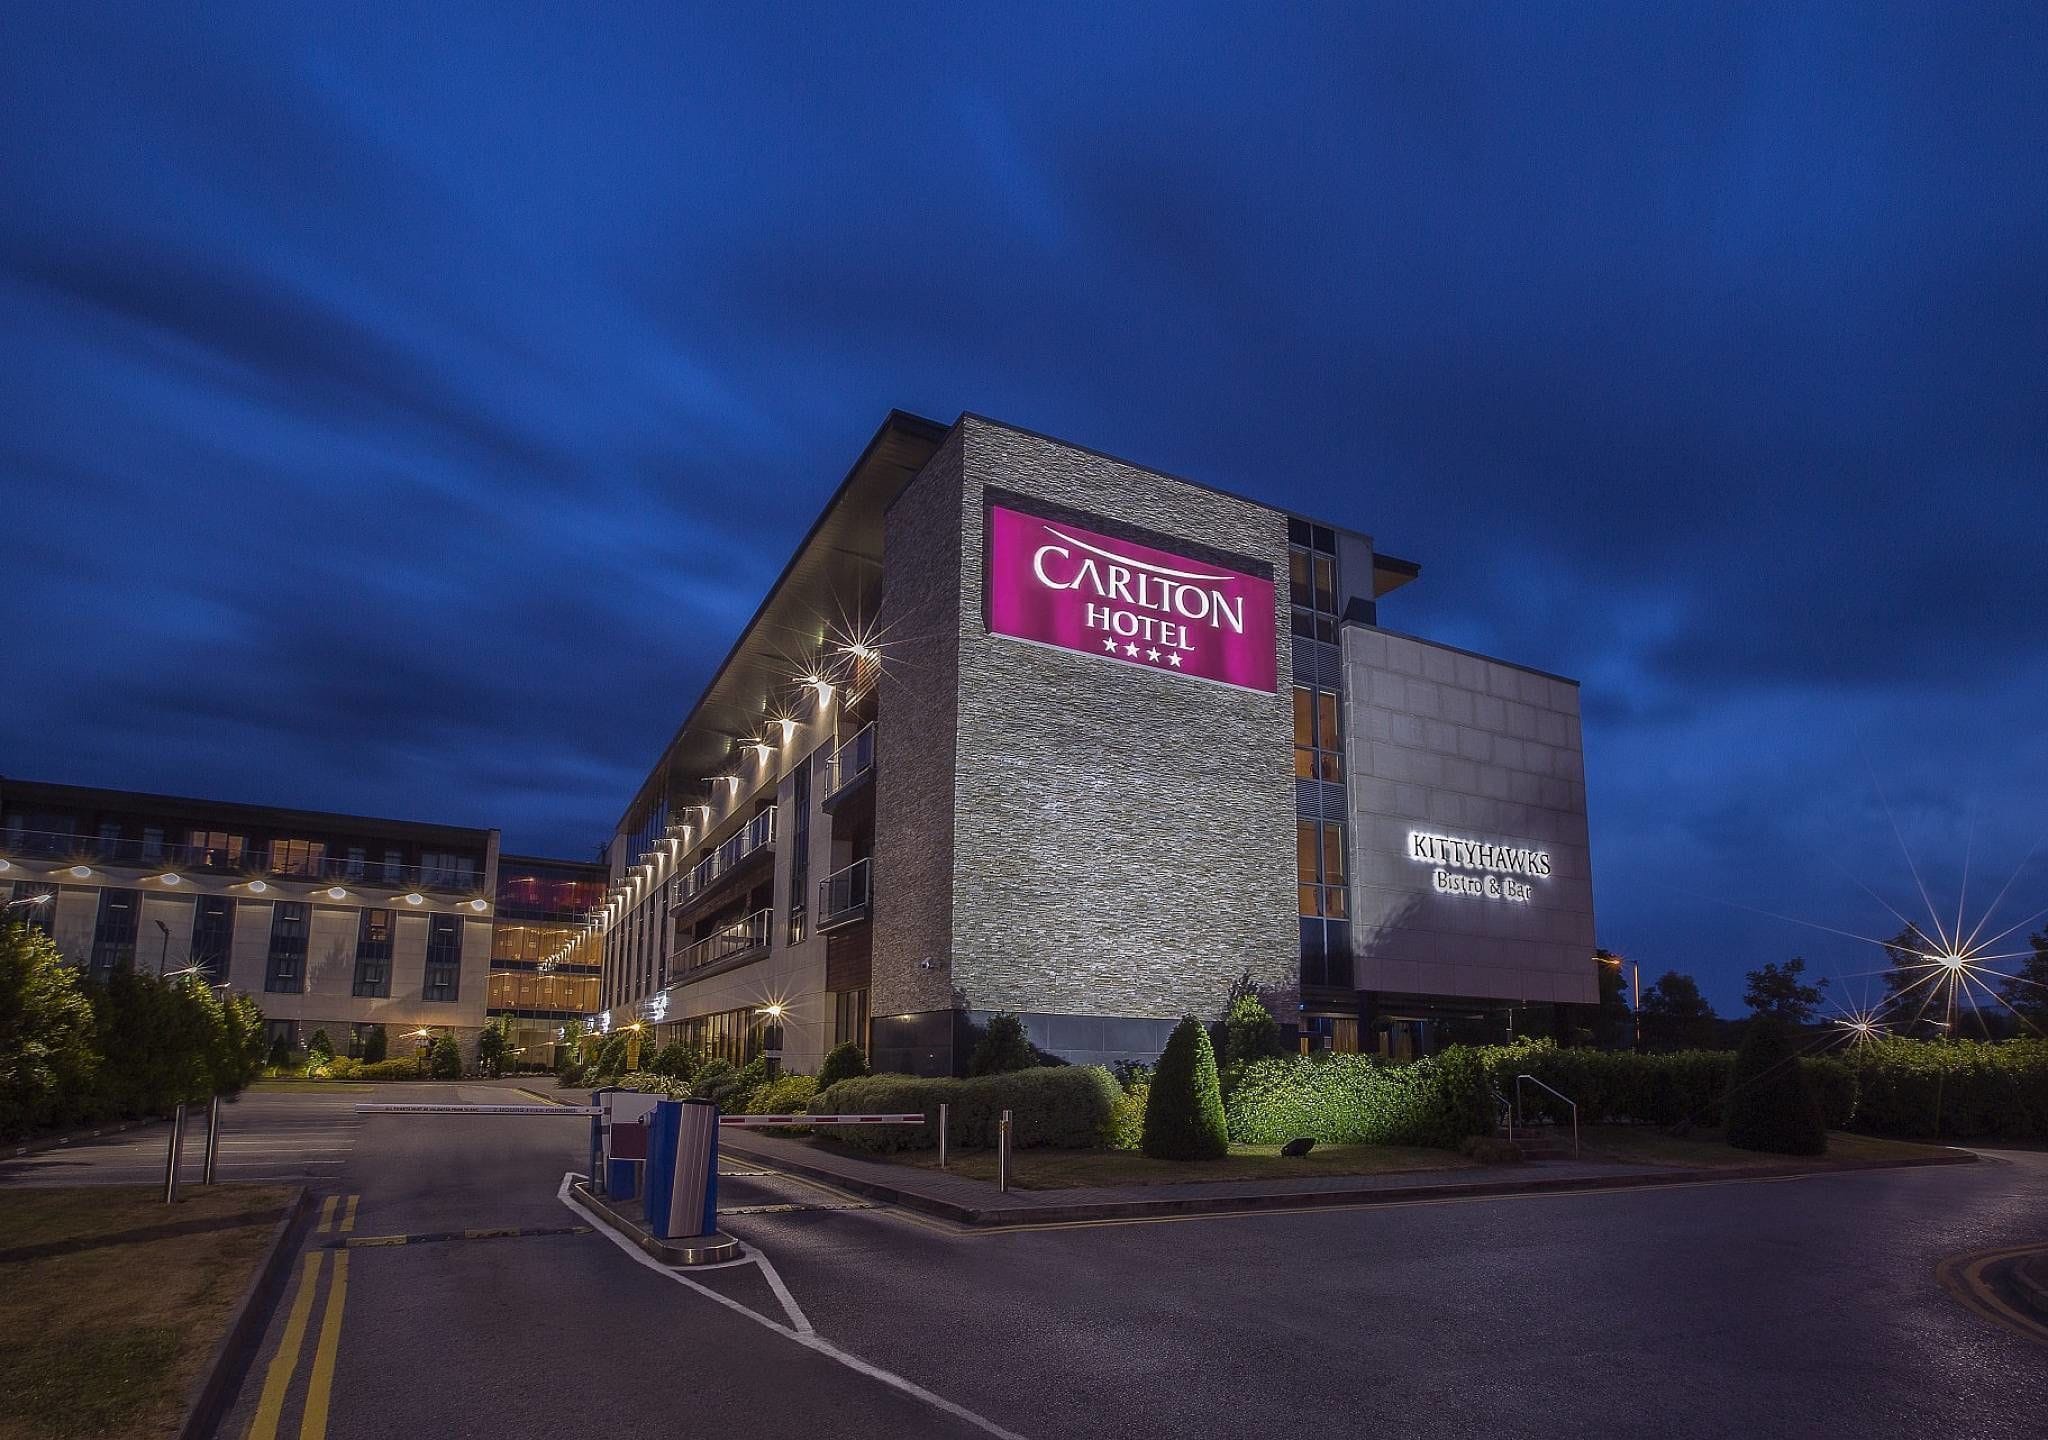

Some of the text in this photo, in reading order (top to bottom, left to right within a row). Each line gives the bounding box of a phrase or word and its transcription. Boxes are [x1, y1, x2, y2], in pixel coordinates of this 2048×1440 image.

[1033, 545, 1244, 634] CARLTON
[1086, 602, 1195, 651] HOTEL
[1413, 834, 1551, 875] KITTYHAWKS
[1437, 871, 1532, 899] Bistro & Bar
